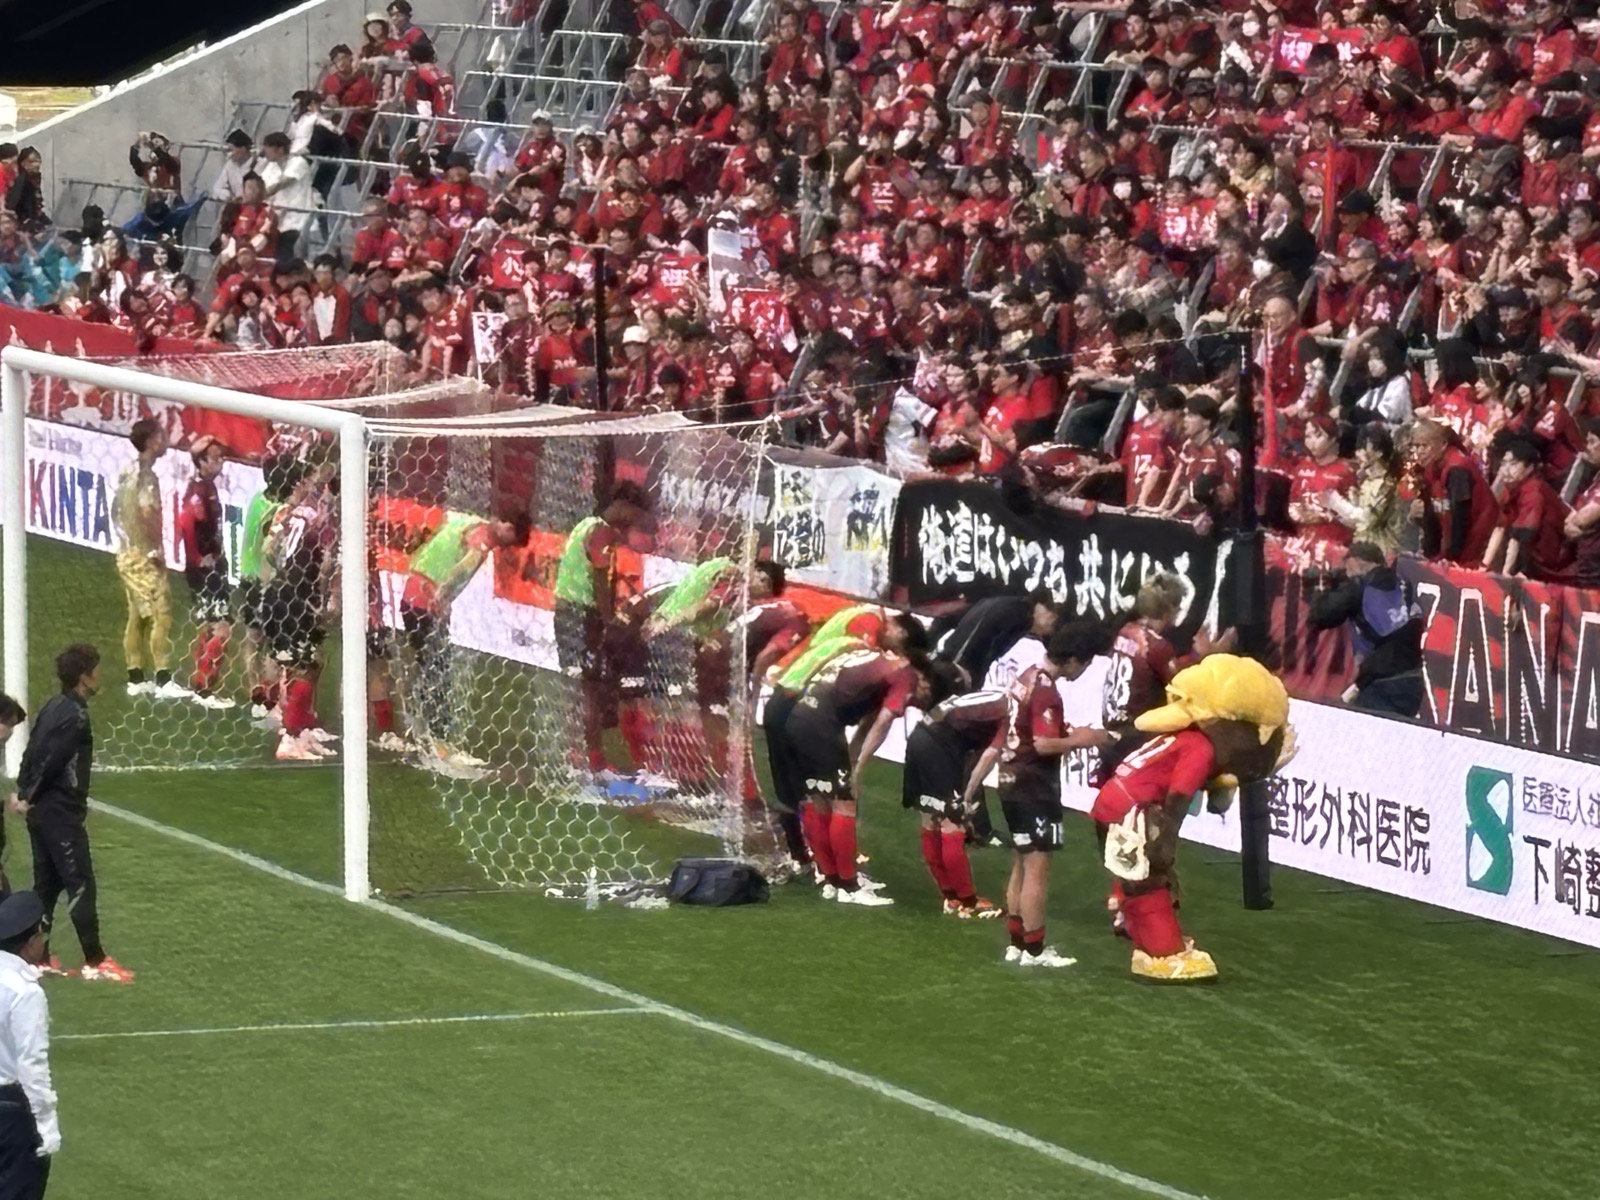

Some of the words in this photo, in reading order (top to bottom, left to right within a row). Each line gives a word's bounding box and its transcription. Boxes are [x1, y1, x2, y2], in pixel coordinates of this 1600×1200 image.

[29, 458, 113, 546] KINTA
[1267, 774, 1431, 876] 整形外科医院
